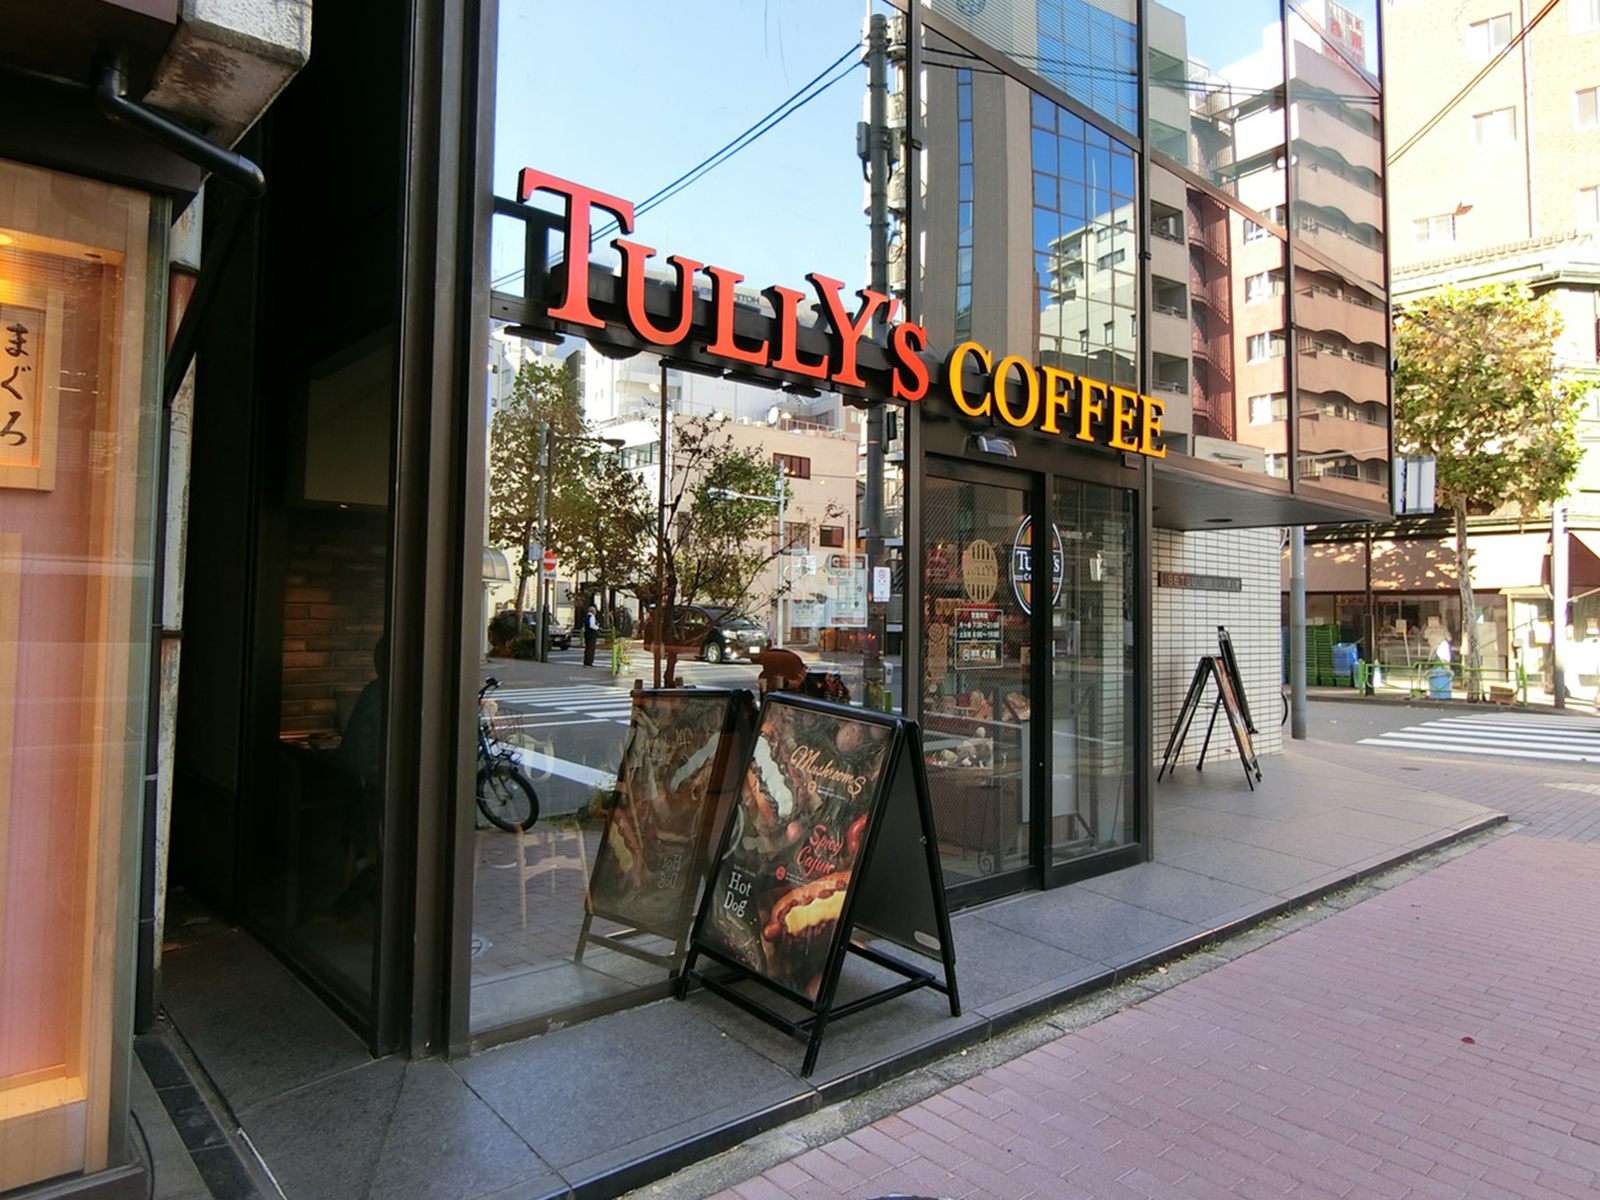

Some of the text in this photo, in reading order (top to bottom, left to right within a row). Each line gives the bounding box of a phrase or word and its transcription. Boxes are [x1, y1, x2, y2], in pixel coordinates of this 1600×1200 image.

[517, 167, 1167, 458] TULLY'S COFFEE
[1, 323, 31, 446] まぐろ
[809, 824, 843, 858] Spicy
[796, 845, 835, 877] Cajun
[728, 871, 752, 897] Hot
[723, 891, 748, 918] Dog
